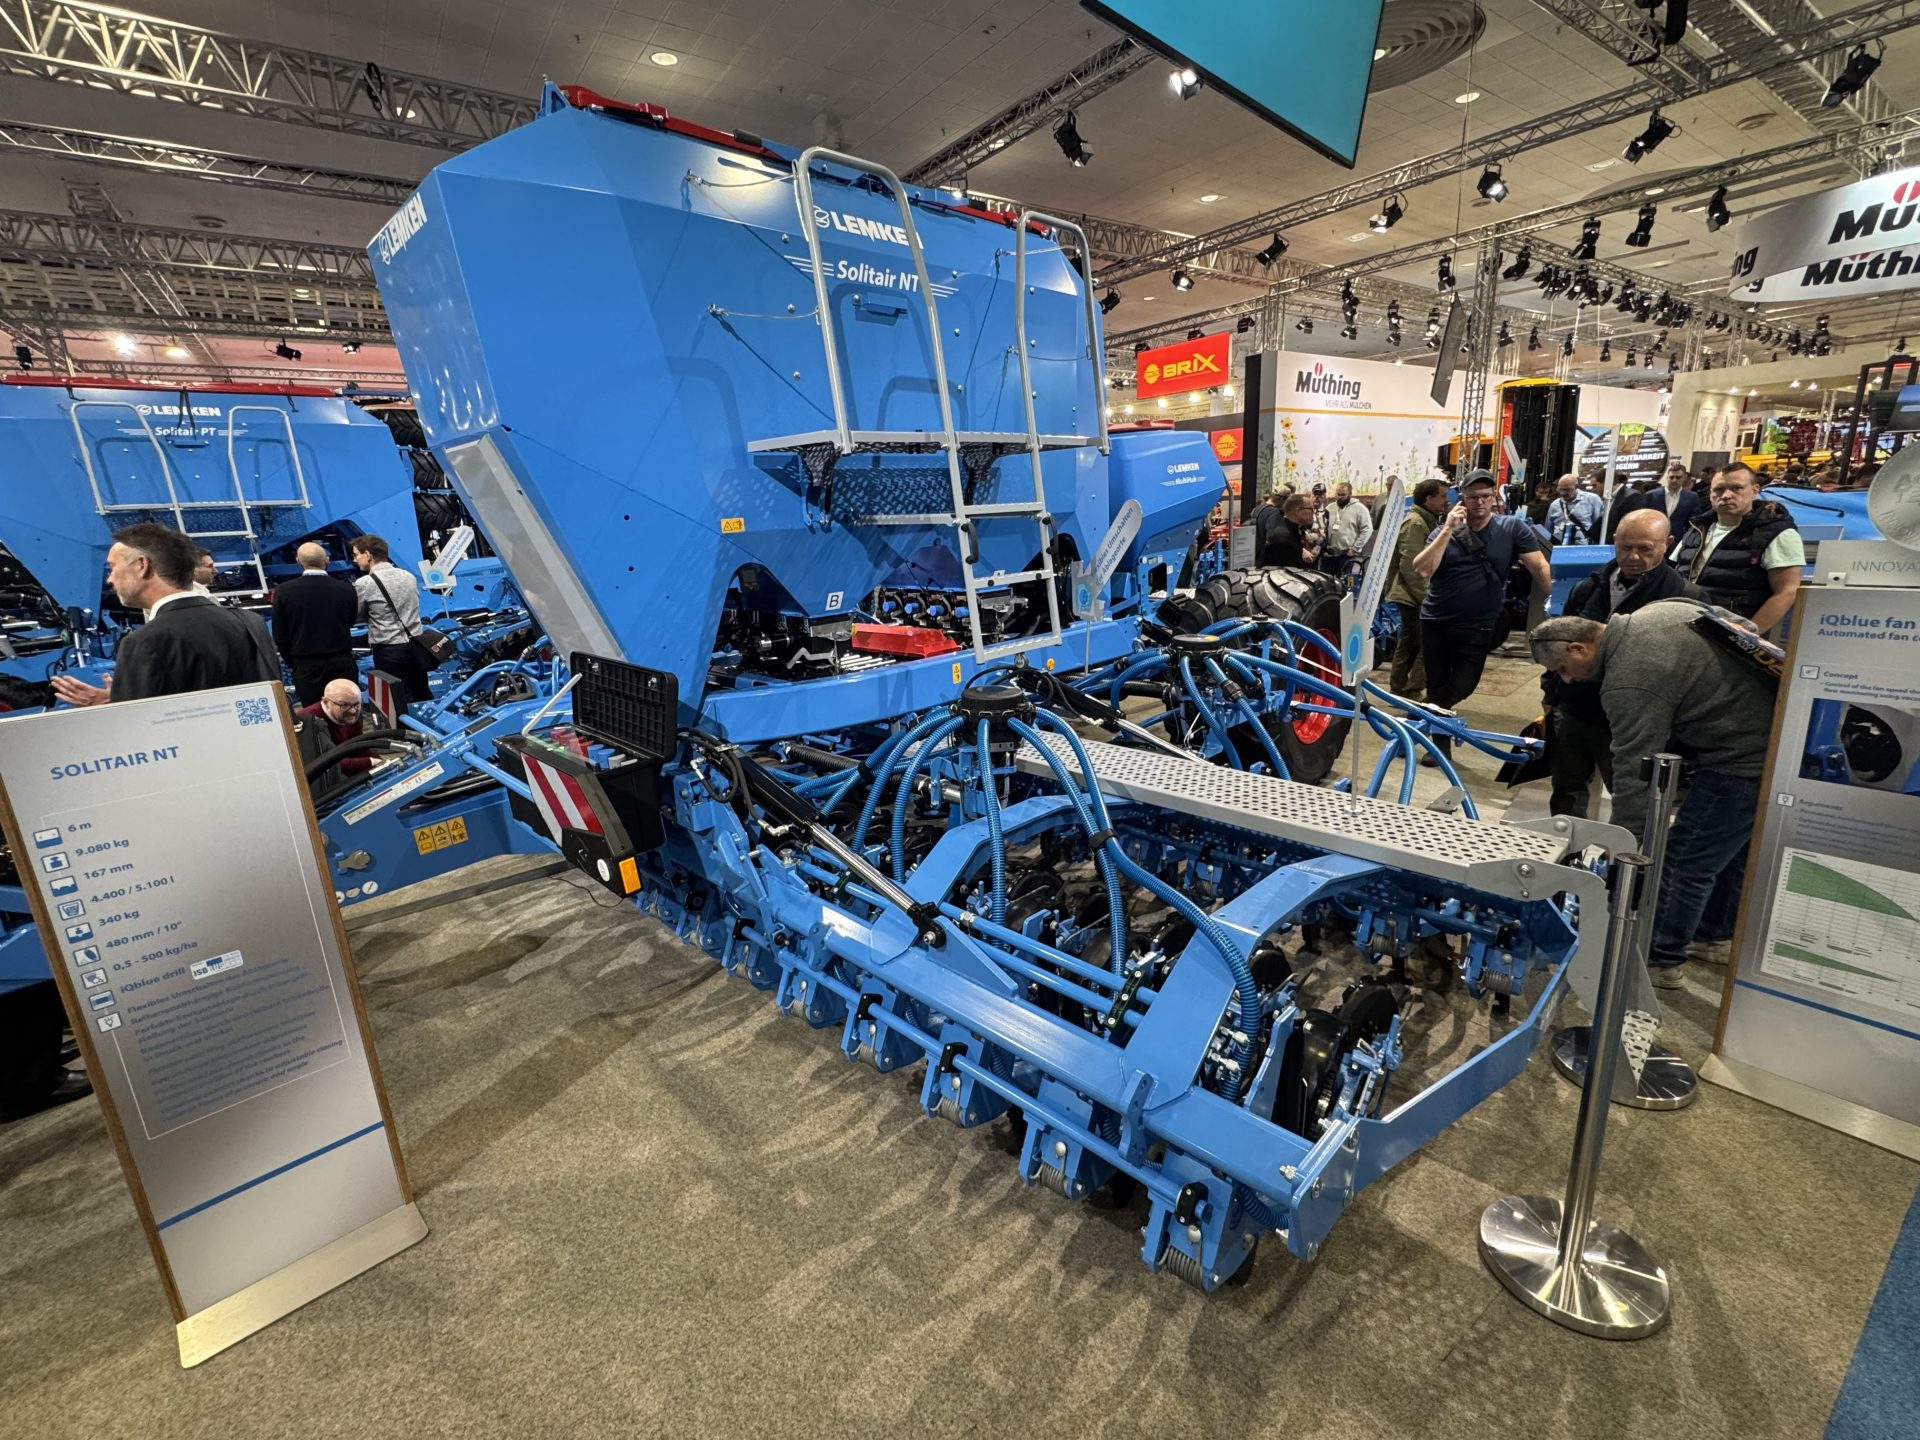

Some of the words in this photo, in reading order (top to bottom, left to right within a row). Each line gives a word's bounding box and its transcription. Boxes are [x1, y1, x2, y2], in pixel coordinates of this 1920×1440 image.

[1828, 181, 1920, 245] Mü
[385, 192, 427, 257] LEMKEN
[837, 260, 896, 288] Solitair
[900, 271, 919, 292] NT
[1163, 353, 1221, 378] BRIX
[1295, 362, 1361, 400] Müthing
[155, 427, 198, 436] Solitair
[201, 428, 216, 436] PT
[1174, 462, 1199, 473] LEMKEN
[829, 594, 840, 608] B
[1820, 614, 1880, 628] iQblue
[1885, 617, 1916, 629] fan
[1818, 628, 1885, 640] Automated
[1889, 632, 1909, 641] fan
[1824, 671, 1858, 680] Concept
[50, 751, 149, 780] SOLITAIR
[153, 746, 179, 763] NT
[68, 824, 77, 832] 6
[80, 822, 92, 830] m
[75, 842, 111, 857] 9.080
[113, 838, 130, 850] kg
[83, 868, 106, 880] 167
[110, 862, 134, 874] mm
[91, 888, 126, 903] 4.400
[135, 877, 168, 892] 5.100
[98, 914, 122, 927] 340
[124, 910, 140, 921] kg
[105, 936, 129, 949] 480
[131, 930, 155, 942] mm
[113, 959, 132, 972] 0,5
[141, 950, 164, 963] 500
[165, 940, 198, 957] kg/ha
[162, 966, 186, 980] drill
